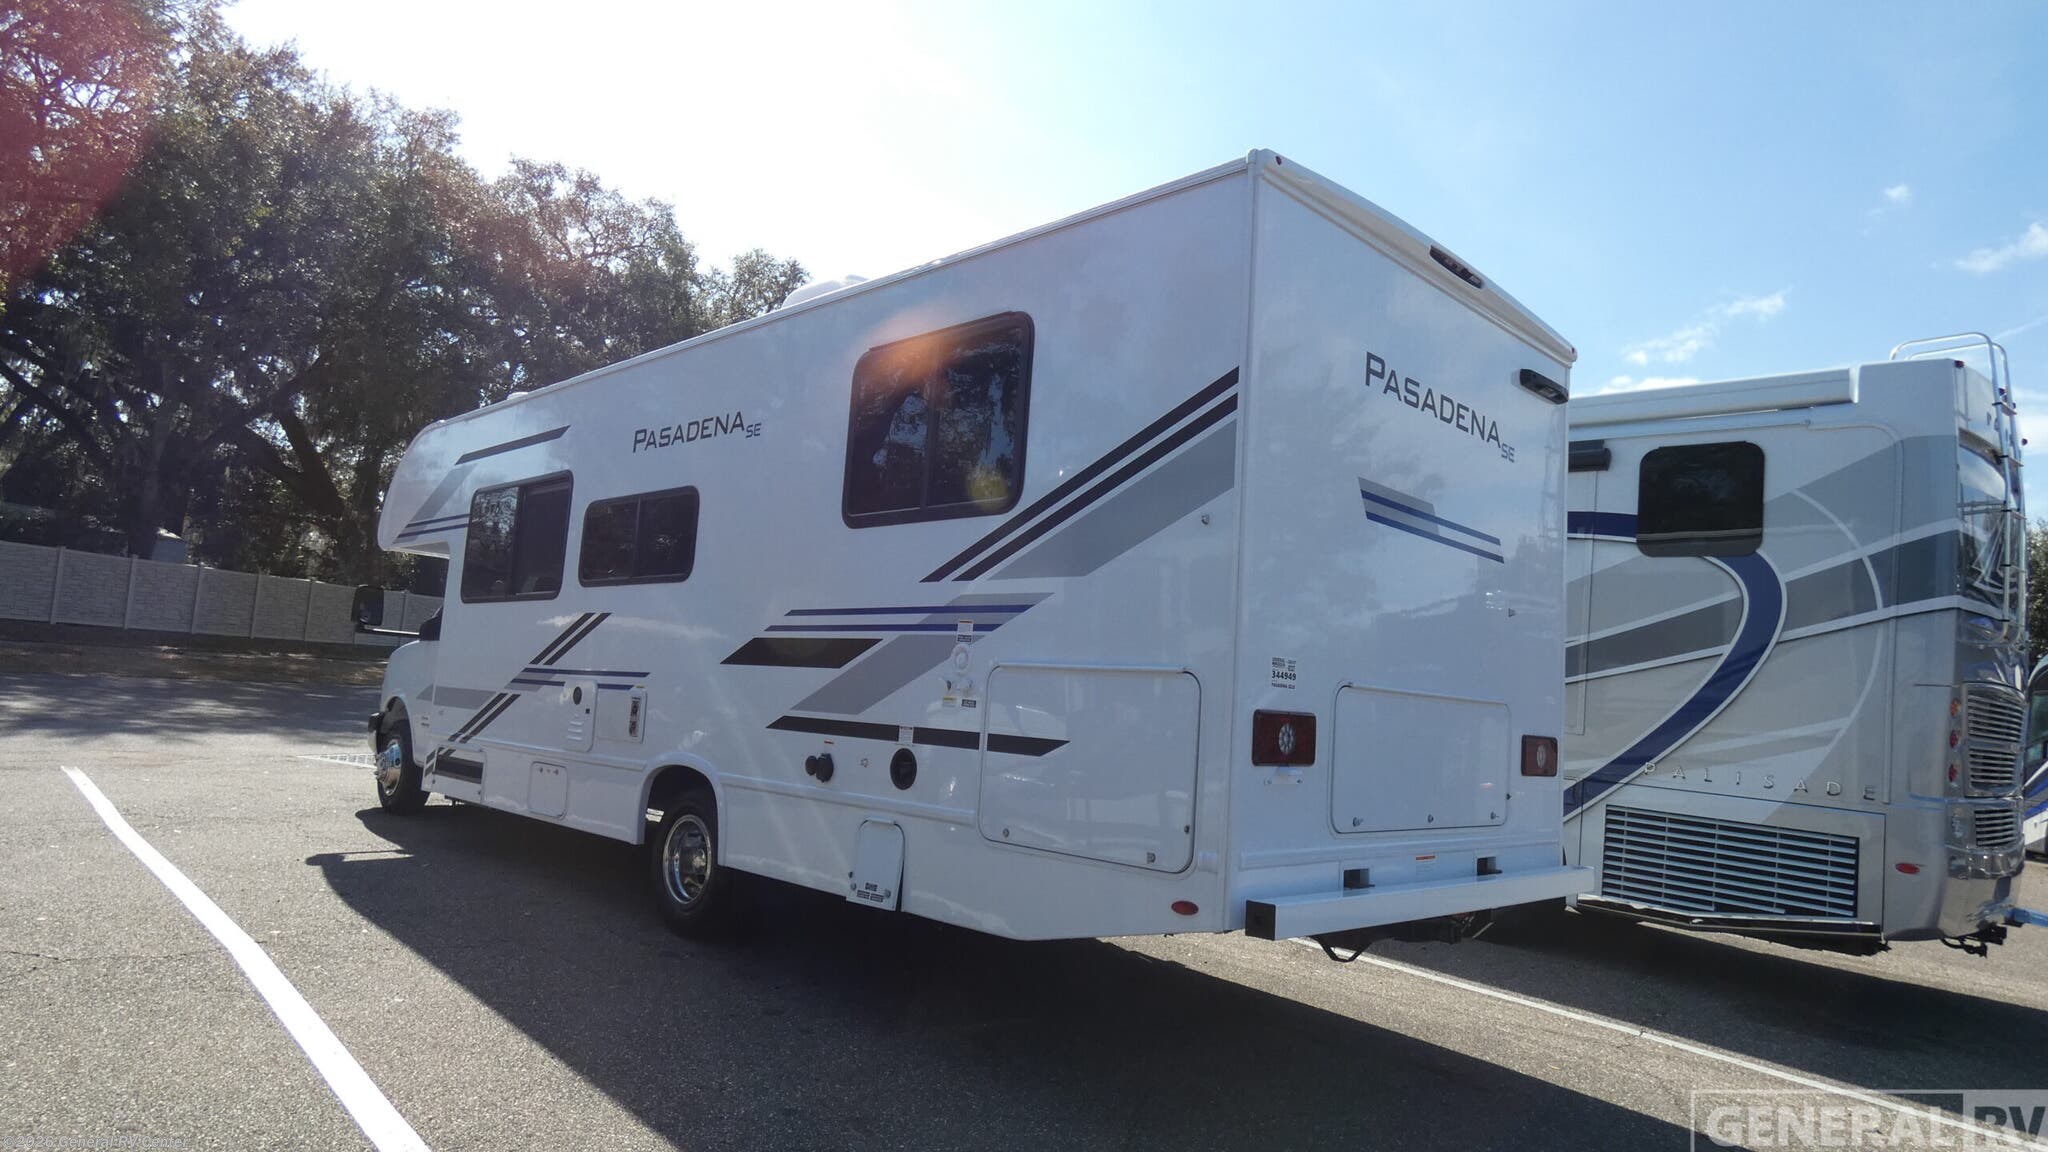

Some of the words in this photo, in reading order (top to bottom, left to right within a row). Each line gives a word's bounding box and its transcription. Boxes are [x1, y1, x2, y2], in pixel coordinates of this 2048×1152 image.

[1365, 351, 1501, 448] PASADENA
[1501, 443, 1515, 463] SE
[633, 411, 745, 453] PASADENA
[745, 423, 762, 438] SE
[1645, 762, 1875, 800] PALISADE
